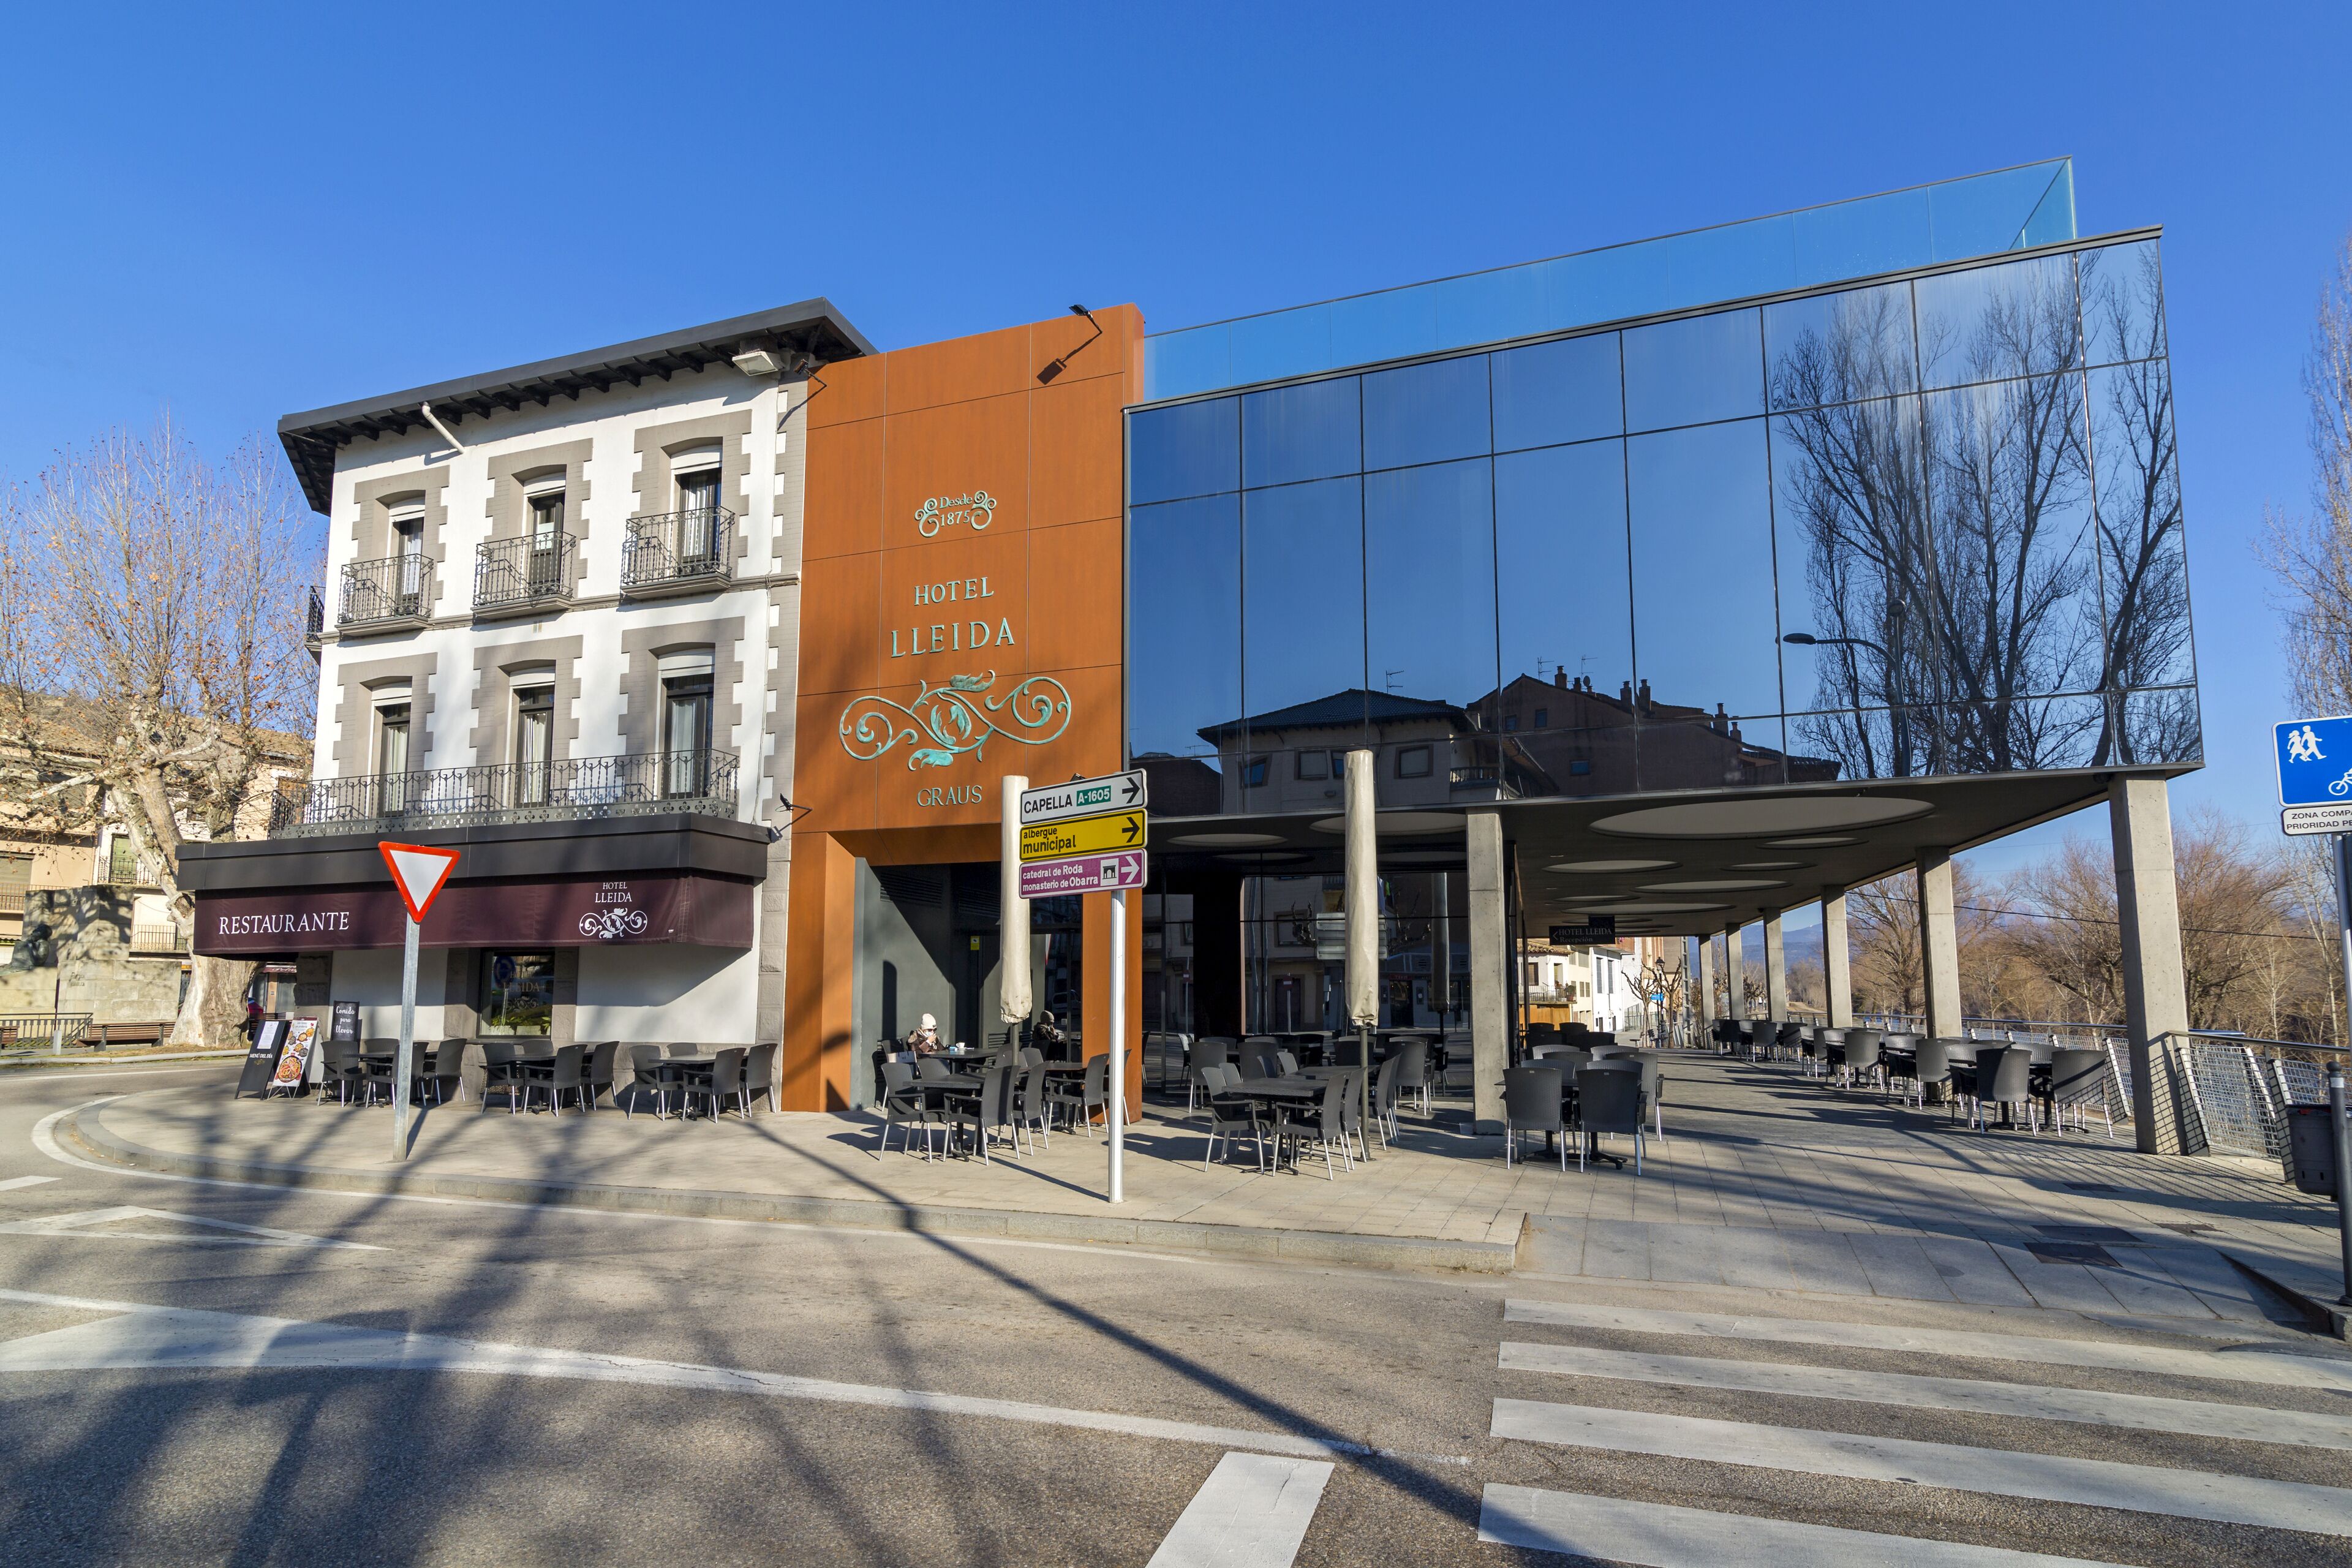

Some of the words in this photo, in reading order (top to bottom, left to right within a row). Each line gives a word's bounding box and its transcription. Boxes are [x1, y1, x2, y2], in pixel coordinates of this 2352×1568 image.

[939, 493, 973, 509] Desde
[940, 510, 970, 527] 1875
[914, 577, 994, 606] HOTEL
[891, 617, 1015, 657] LLEIDA
[917, 785, 982, 807] GRAUS
[1024, 794, 1072, 813] CAPELLA
[1077, 788, 1110, 804] A-1605
[1023, 827, 1057, 839] albergue
[2286, 821, 2339, 829] PRIORIDAD
[1023, 835, 1076, 854] municipal
[1023, 868, 1051, 880] catedral
[1052, 866, 1061, 875] de
[1063, 864, 1083, 875] Roda
[1023, 880, 1058, 892] monasterio
[1060, 878, 1069, 888] de
[1069, 876, 1098, 886] Obarra
[595, 892, 632, 903] LLEIDA
[219, 911, 349, 934] RESTAURANTE
[336, 1006, 355, 1014] Comida
[336, 1025, 354, 1034] llevar
